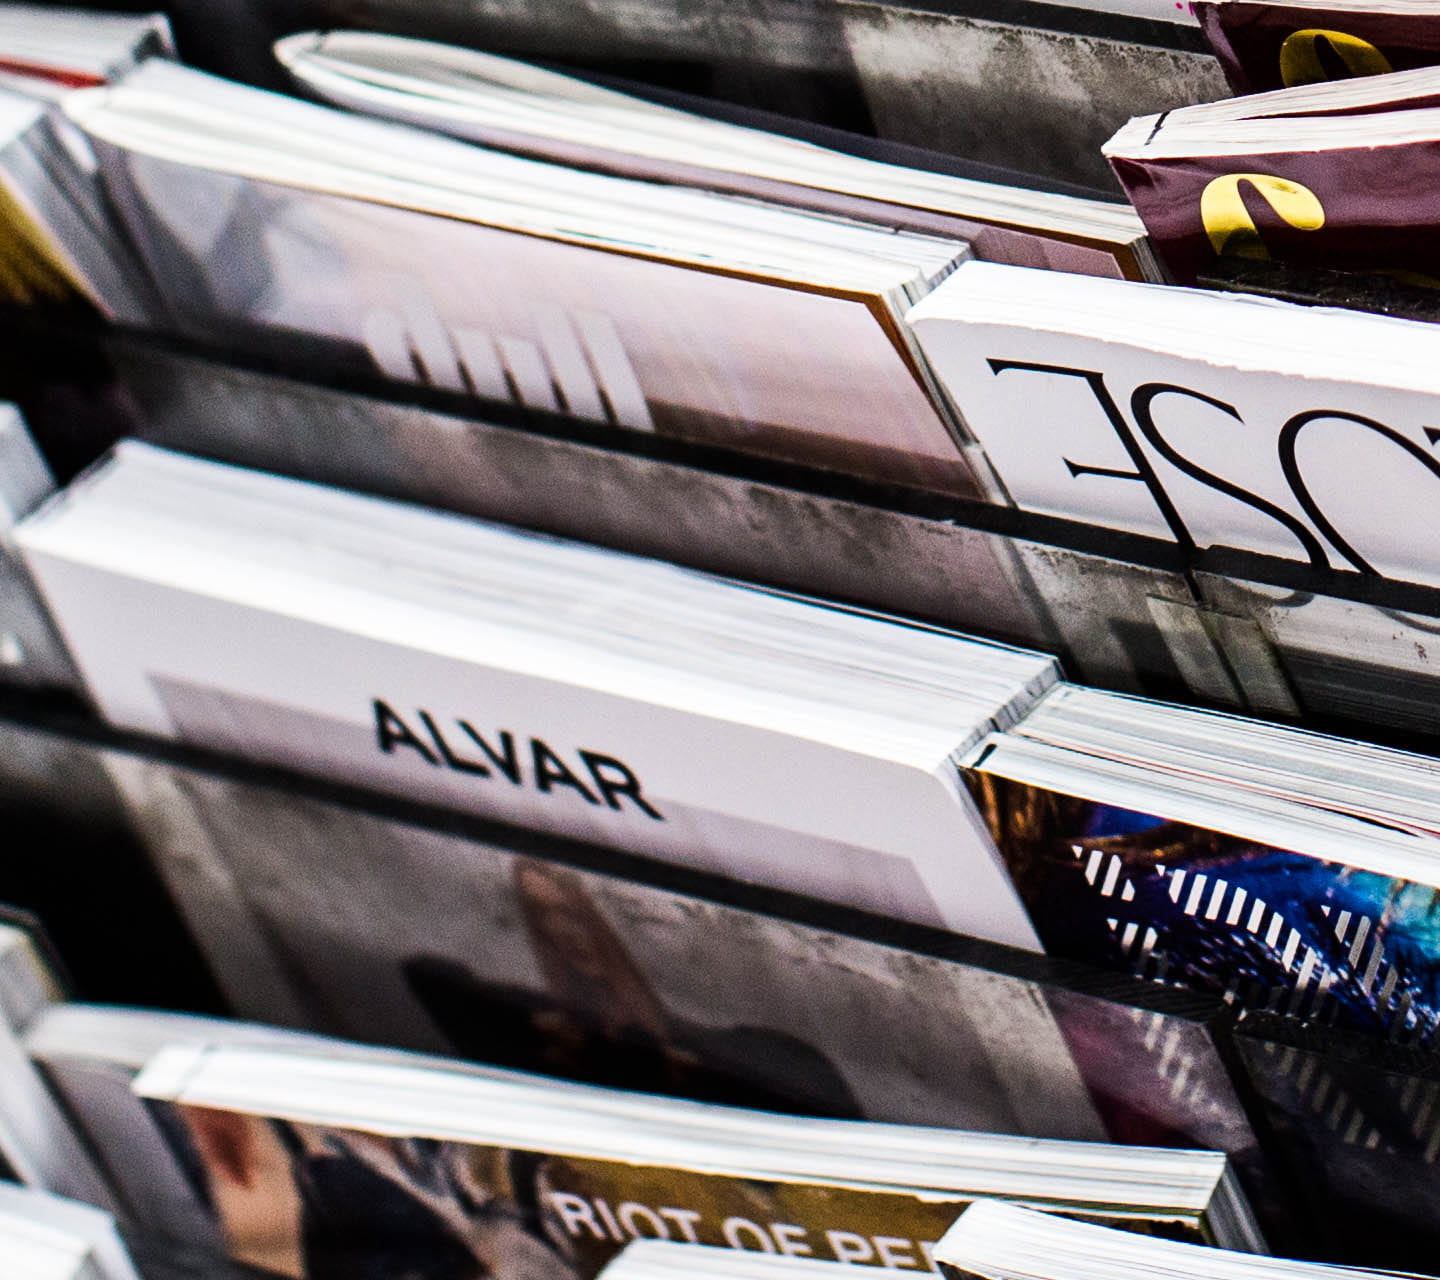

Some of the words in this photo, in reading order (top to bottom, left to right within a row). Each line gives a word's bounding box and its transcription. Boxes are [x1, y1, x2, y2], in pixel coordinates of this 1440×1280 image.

[367, 696, 664, 823] ALVAR
[546, 1191, 703, 1246] RIOT
[720, 1216, 809, 1258] OF
[824, 1227, 941, 1273] PE
